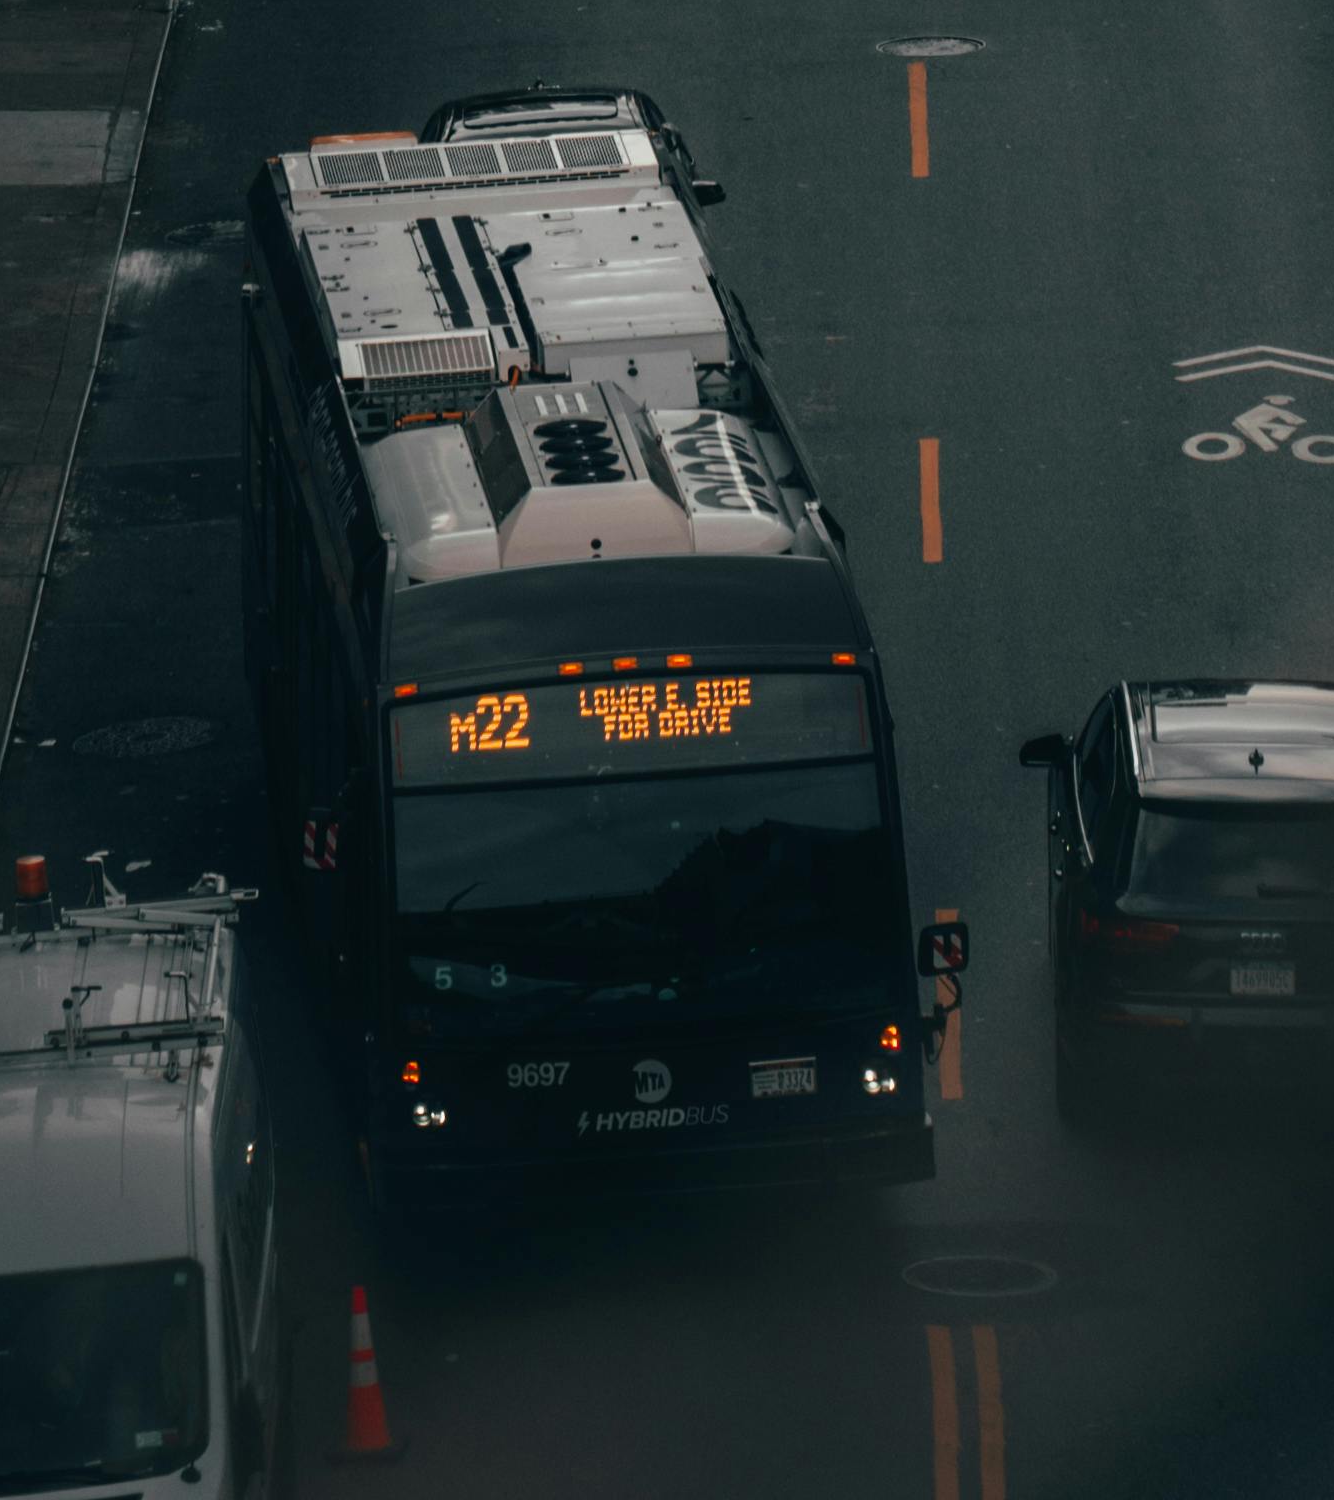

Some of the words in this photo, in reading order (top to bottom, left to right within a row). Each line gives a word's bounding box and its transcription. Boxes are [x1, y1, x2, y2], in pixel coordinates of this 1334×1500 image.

[449, 693, 532, 753] M22
[579, 684, 657, 717] LOWER
[665, 682, 686, 710] E.
[695, 678, 752, 710] SIDE
[658, 707, 733, 739] DRIVE
[434, 965, 454, 990] 5
[489, 963, 508, 987] 3
[506, 1061, 572, 1088] 9697
